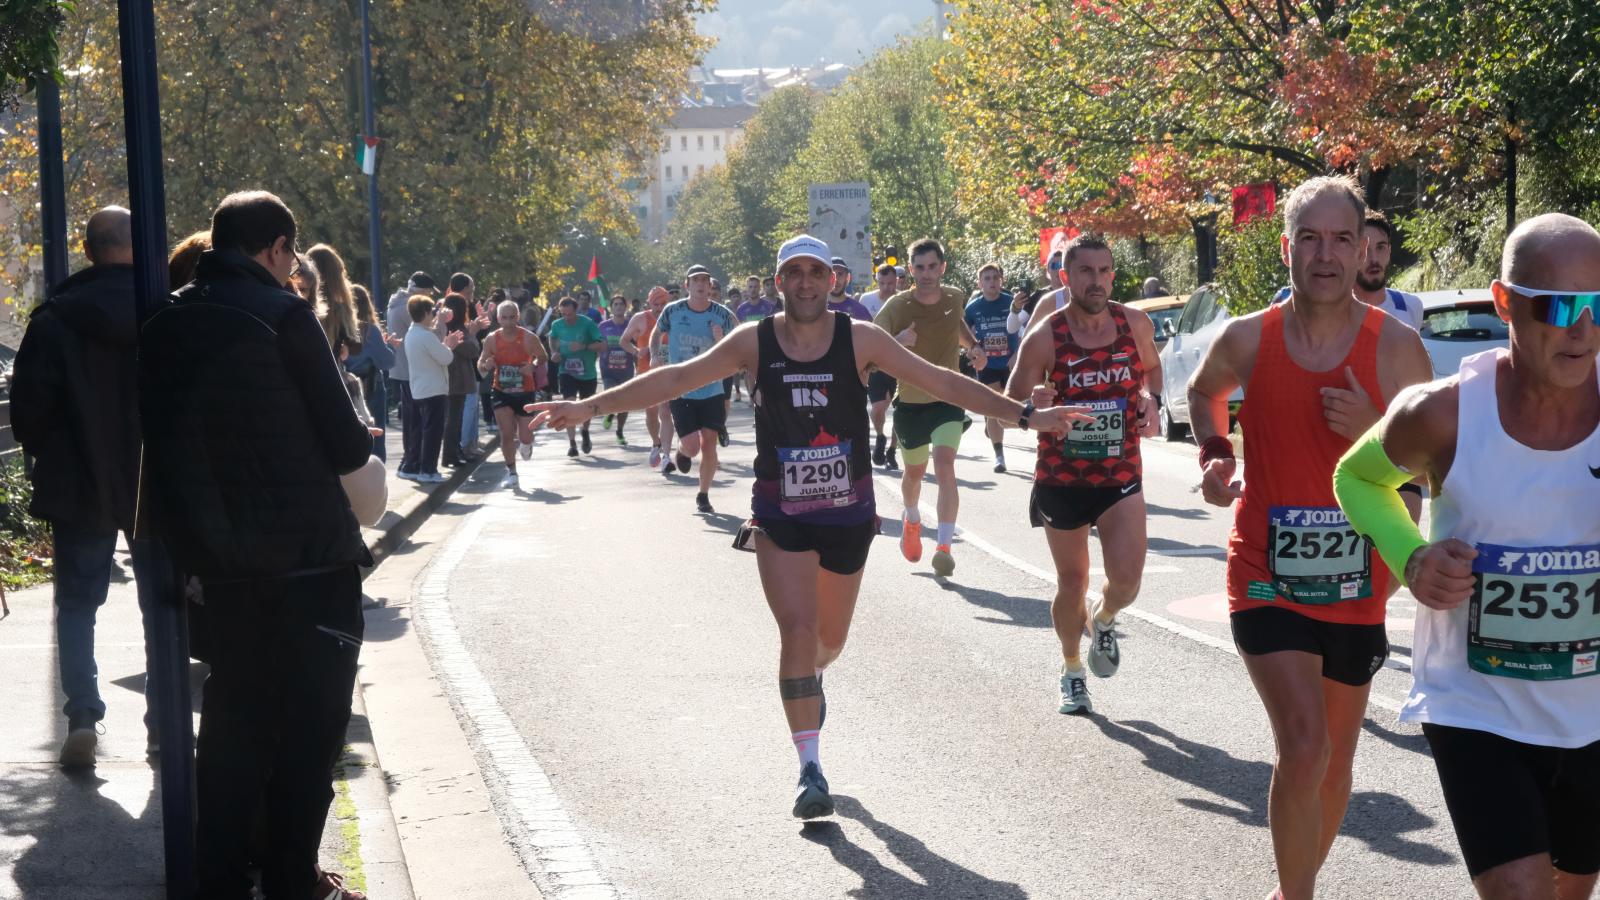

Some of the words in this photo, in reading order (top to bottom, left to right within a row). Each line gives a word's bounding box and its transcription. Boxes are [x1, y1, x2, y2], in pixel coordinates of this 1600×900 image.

[819, 188, 867, 200] ERRENTERIA
[1068, 366, 1132, 388] KENYA
[1082, 433, 1110, 441] JOSUE
[786, 460, 847, 485] 1290
[799, 485, 838, 495] JUANJO
[1301, 509, 1346, 526] Jom
[1277, 530, 1361, 560] 2527
[1483, 579, 1600, 620] 2531
